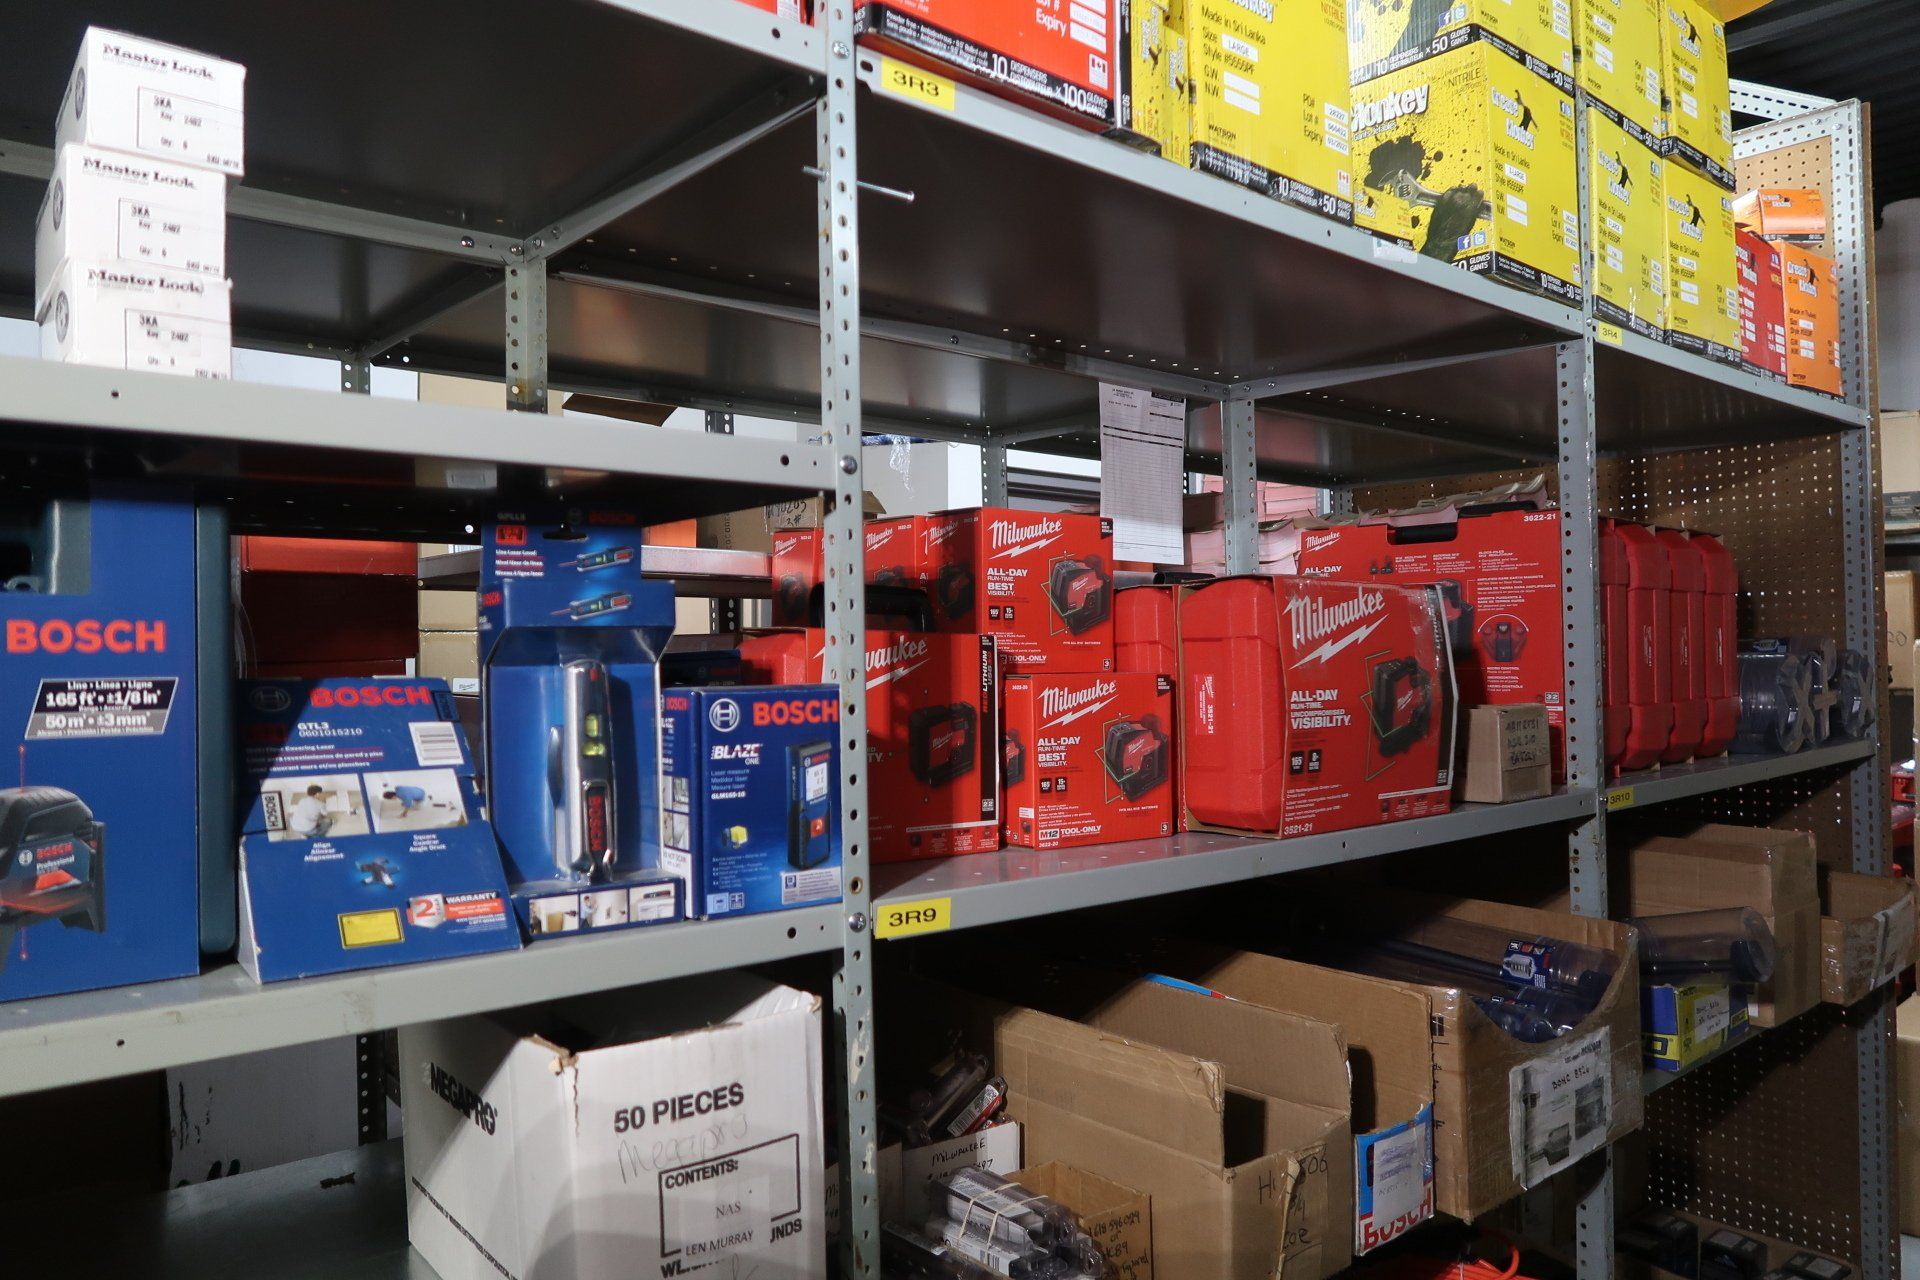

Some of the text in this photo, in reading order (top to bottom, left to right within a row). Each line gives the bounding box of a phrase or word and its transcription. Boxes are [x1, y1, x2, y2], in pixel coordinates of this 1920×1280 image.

[1036, 8, 1067, 37] Expiry
[1201, 5, 1222, 26] Made
[1224, 14, 1232, 28] in
[1234, 18, 1244, 35] Sri
[1245, 26, 1266, 45] Lanka
[1203, 26, 1249, 57] Size LARGE
[1450, 26, 1471, 40] GLOVES
[1450, 35, 1469, 47] GANTS
[1203, 44, 1222, 62] Style
[1432, 36, 1448, 54] 50
[103, 43, 215, 81] Master Lock
[991, 53, 1008, 79] 10
[1374, 60, 1388, 76] 10
[1010, 60, 1048, 85] DISPENSERS
[1447, 67, 1480, 88] NITRILE
[1554, 70, 1563, 86] 50
[893, 69, 940, 97] 3R3
[1063, 83, 1087, 112] 100
[1303, 110, 1313, 122] Lot
[1209, 123, 1237, 141] WATSON
[1304, 126, 1323, 146] Expiry
[83, 156, 197, 190] Master Lock
[1278, 177, 1289, 196] 10
[132, 204, 150, 217] 3KA
[1323, 195, 1337, 214] 50
[1469, 254, 1491, 265] GLOVES
[1469, 261, 1489, 273] GANTS
[87, 269, 204, 296] Master Lock
[1540, 272, 1548, 288] 10
[1567, 284, 1575, 298] 50
[140, 314, 158, 327] 3KA
[1523, 513, 1557, 522] 3622-21
[866, 527, 894, 549] Milwaukee
[988, 516, 1063, 550] Milwaukee
[1305, 531, 1340, 548] Milwaukee
[774, 536, 797, 552] Milwaukee
[987, 568, 1028, 577] ALL-DAY
[1305, 565, 1342, 575] ALL-DAY
[987, 582, 1015, 591] BEST
[1283, 587, 1386, 650] Milwaukee
[6, 619, 167, 653] BOSCH
[1008, 655, 1047, 663] TOOL-ONLY
[68, 681, 88, 691] Line
[128, 680, 153, 691] Ligne
[46, 692, 77, 707] 165
[310, 686, 432, 707] BOSCH
[1037, 679, 1117, 718] Milwaukee
[1291, 689, 1338, 702] ALL-DAY
[752, 700, 840, 726] BOSCH
[1291, 708, 1345, 717] UNCOMPROMISED
[45, 714, 67, 729] 50
[297, 721, 329, 730] GTL3
[1037, 736, 1081, 746] ALL-DAY
[712, 743, 761, 759] BLAZE
[1038, 752, 1066, 761] BEST
[745, 757, 760, 765] ONE
[1610, 792, 1630, 804] 3R10
[264, 793, 277, 829] BOSCH
[1040, 825, 1101, 839] M12 TOOL-ONLY
[1162, 823, 1168, 831] 3
[1284, 822, 1313, 835] 3521-21
[304, 853, 345, 862] Alignement
[415, 899, 436, 918] 2
[446, 891, 497, 904] WARRANTY
[889, 907, 937, 927] 3R9
[429, 1061, 499, 1137] MEGAPRO
[614, 1082, 745, 1134] 50 PIECES
[931, 1137, 986, 1167] MILWAUKEE
[665, 1159, 739, 1190] CONTENTS:
[715, 1201, 742, 1219] NAS
[686, 1230, 754, 1257] LEN MURRAY
